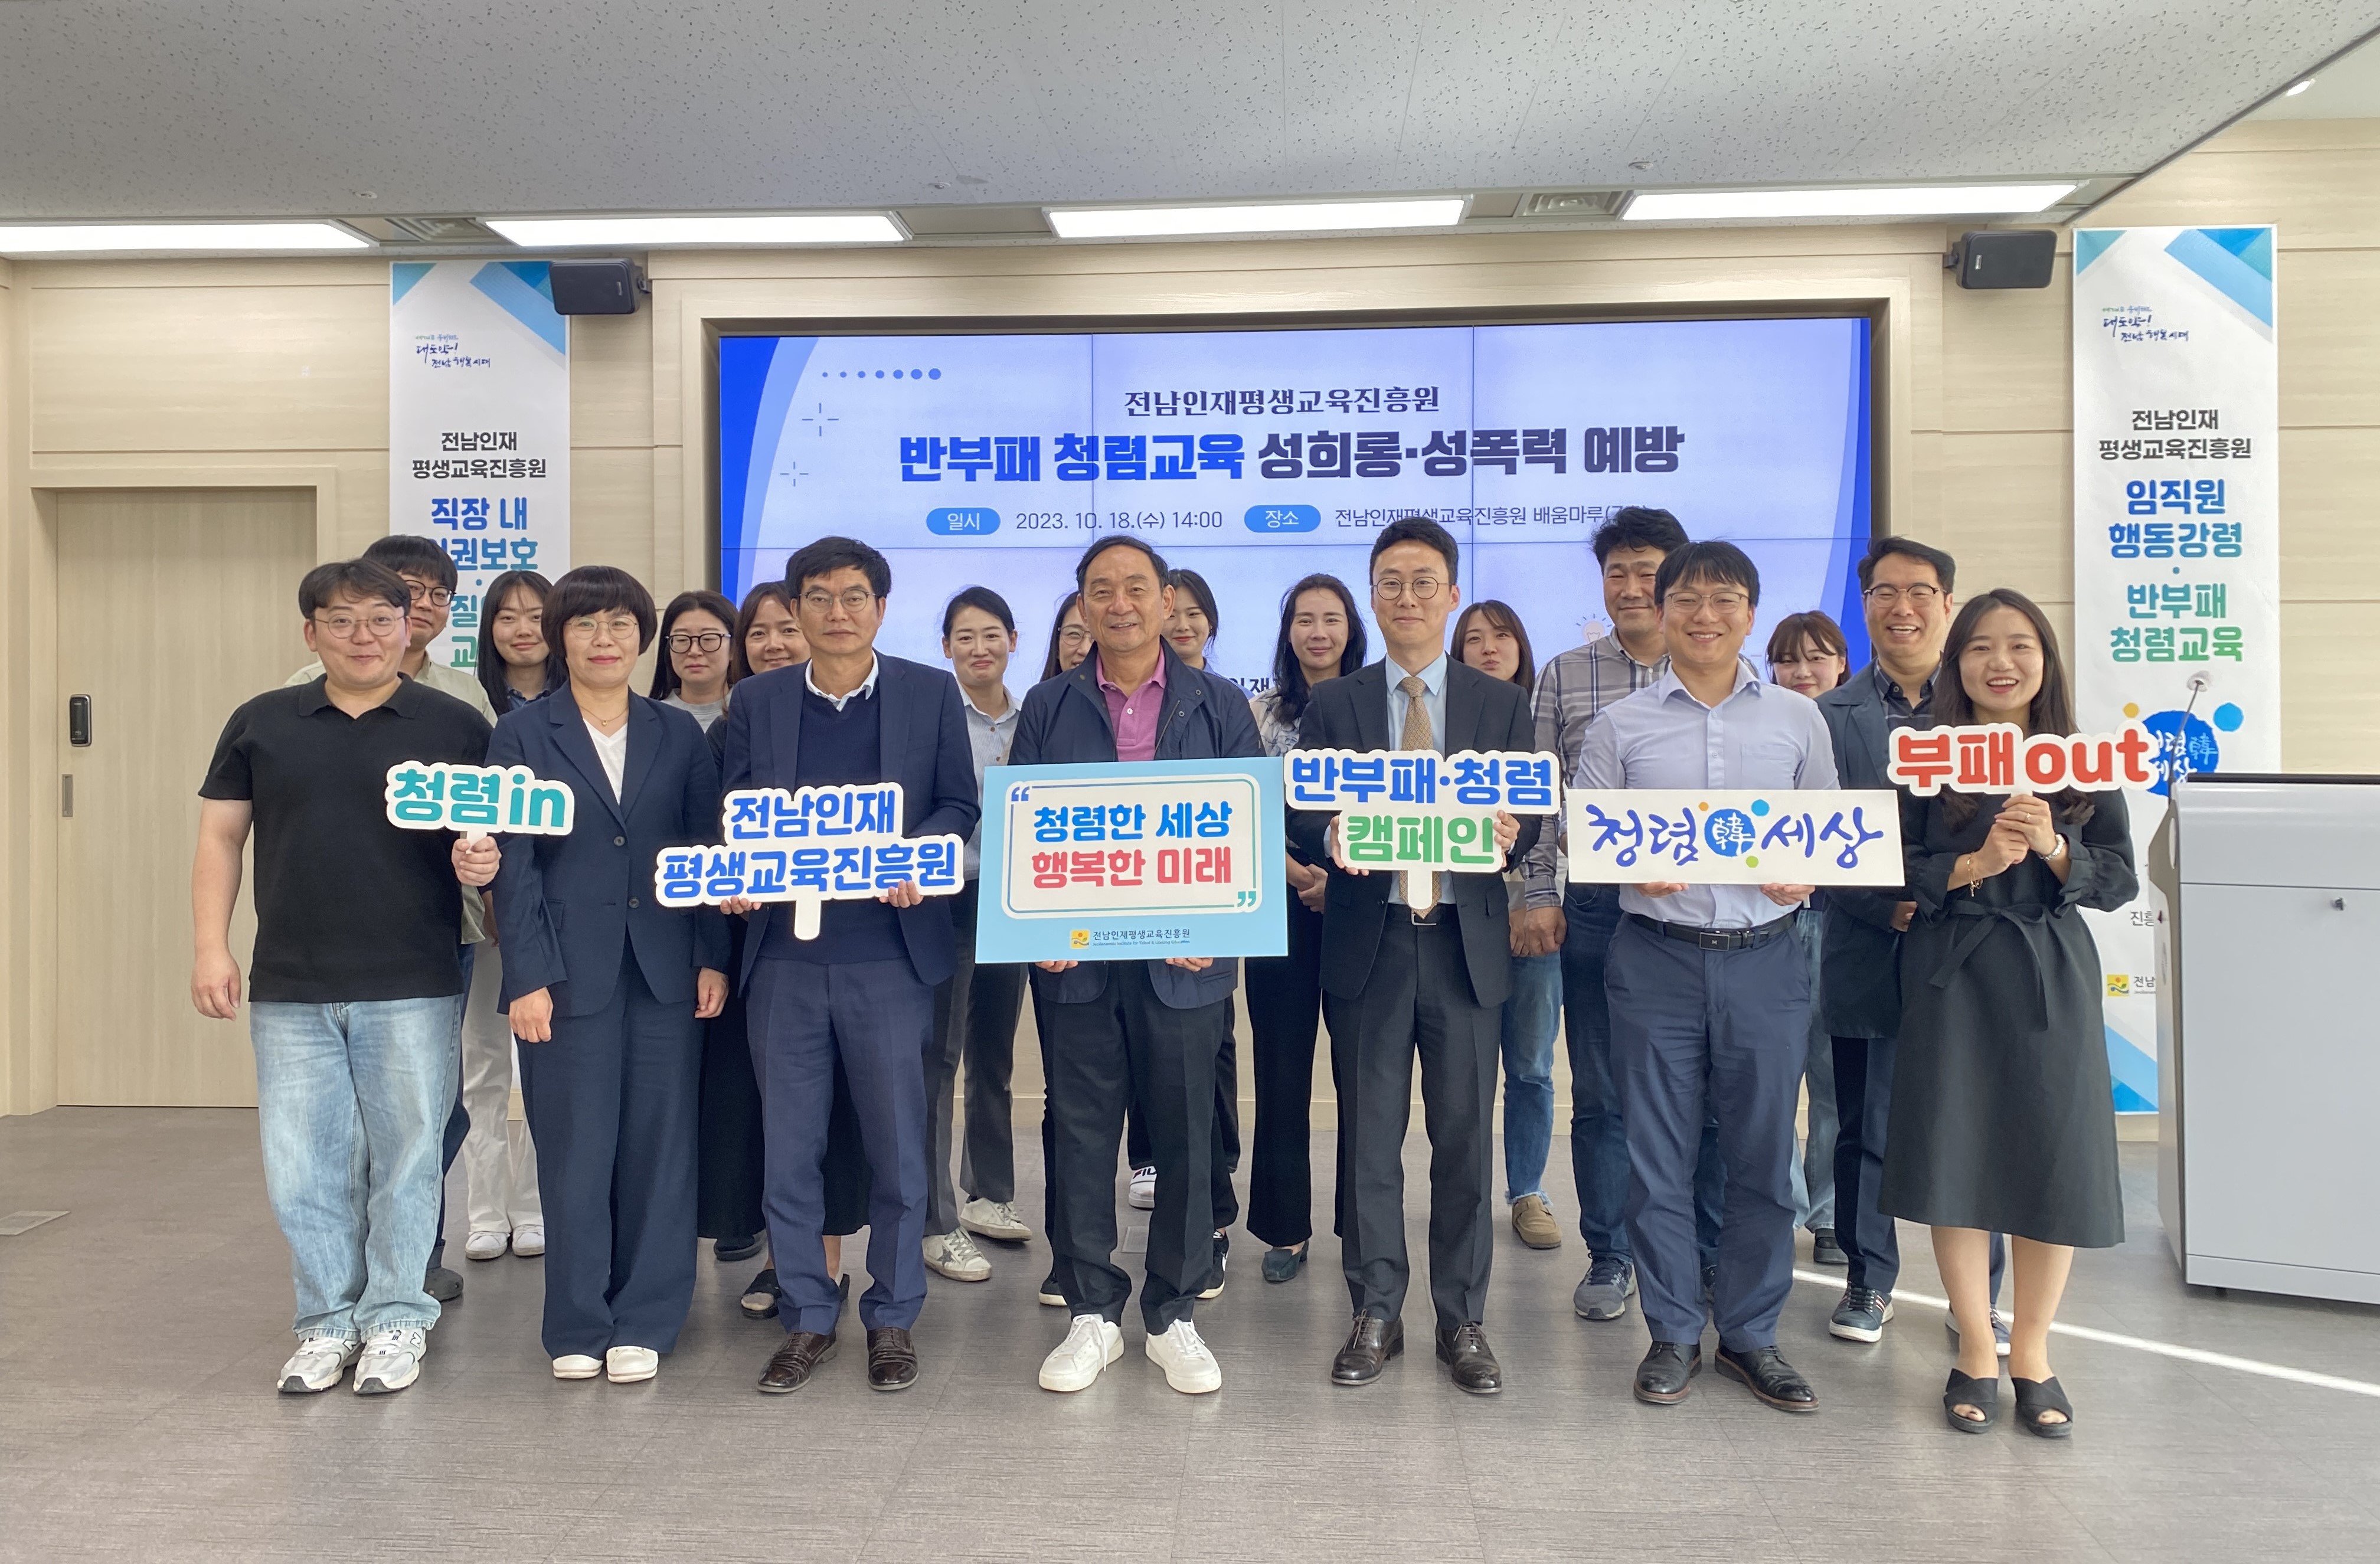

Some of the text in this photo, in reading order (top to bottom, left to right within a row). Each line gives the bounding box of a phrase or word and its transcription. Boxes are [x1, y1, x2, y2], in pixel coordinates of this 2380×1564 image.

[1124, 386, 1439, 417] 전남인재평생교육진흥원
[2132, 409, 2219, 431] 전남인재
[442, 431, 517, 451] 전남인재
[900, 426, 1685, 482] 반부패 청렴교육 성희롱·성폭력 예방
[2100, 437, 2252, 460] 평생교육진흥원
[413, 459, 546, 479] 평생교육진흥원
[431, 497, 527, 530] 직장 내
[2126, 479, 2226, 515] 임직원
[947, 512, 980, 531] 일시
[1016, 513, 1069, 530] 2023.
[1076, 512, 1102, 529] 10.
[1172, 511, 1223, 528] 14:00
[1265, 510, 1299, 528] 장소
[2108, 522, 2242, 558] 행동강령
[450, 594, 486, 628] 질
[2127, 583, 2227, 619] 반부패
[2110, 626, 2243, 663] 청렴교육
[1897, 728, 2150, 787] 부패out
[394, 769, 566, 827] 청렴in
[1293, 756, 1552, 806] 반부패·청렴
[731, 789, 895, 840] 전남인재
[1034, 801, 1232, 843] 청렴한 세상
[1347, 814, 1495, 865] 캠페인
[663, 841, 955, 899] 평생교육진흥원
[1032, 846, 1231, 889] 행복한 미래
[1093, 928, 1191, 941] 전남인재평생교육진흥원
